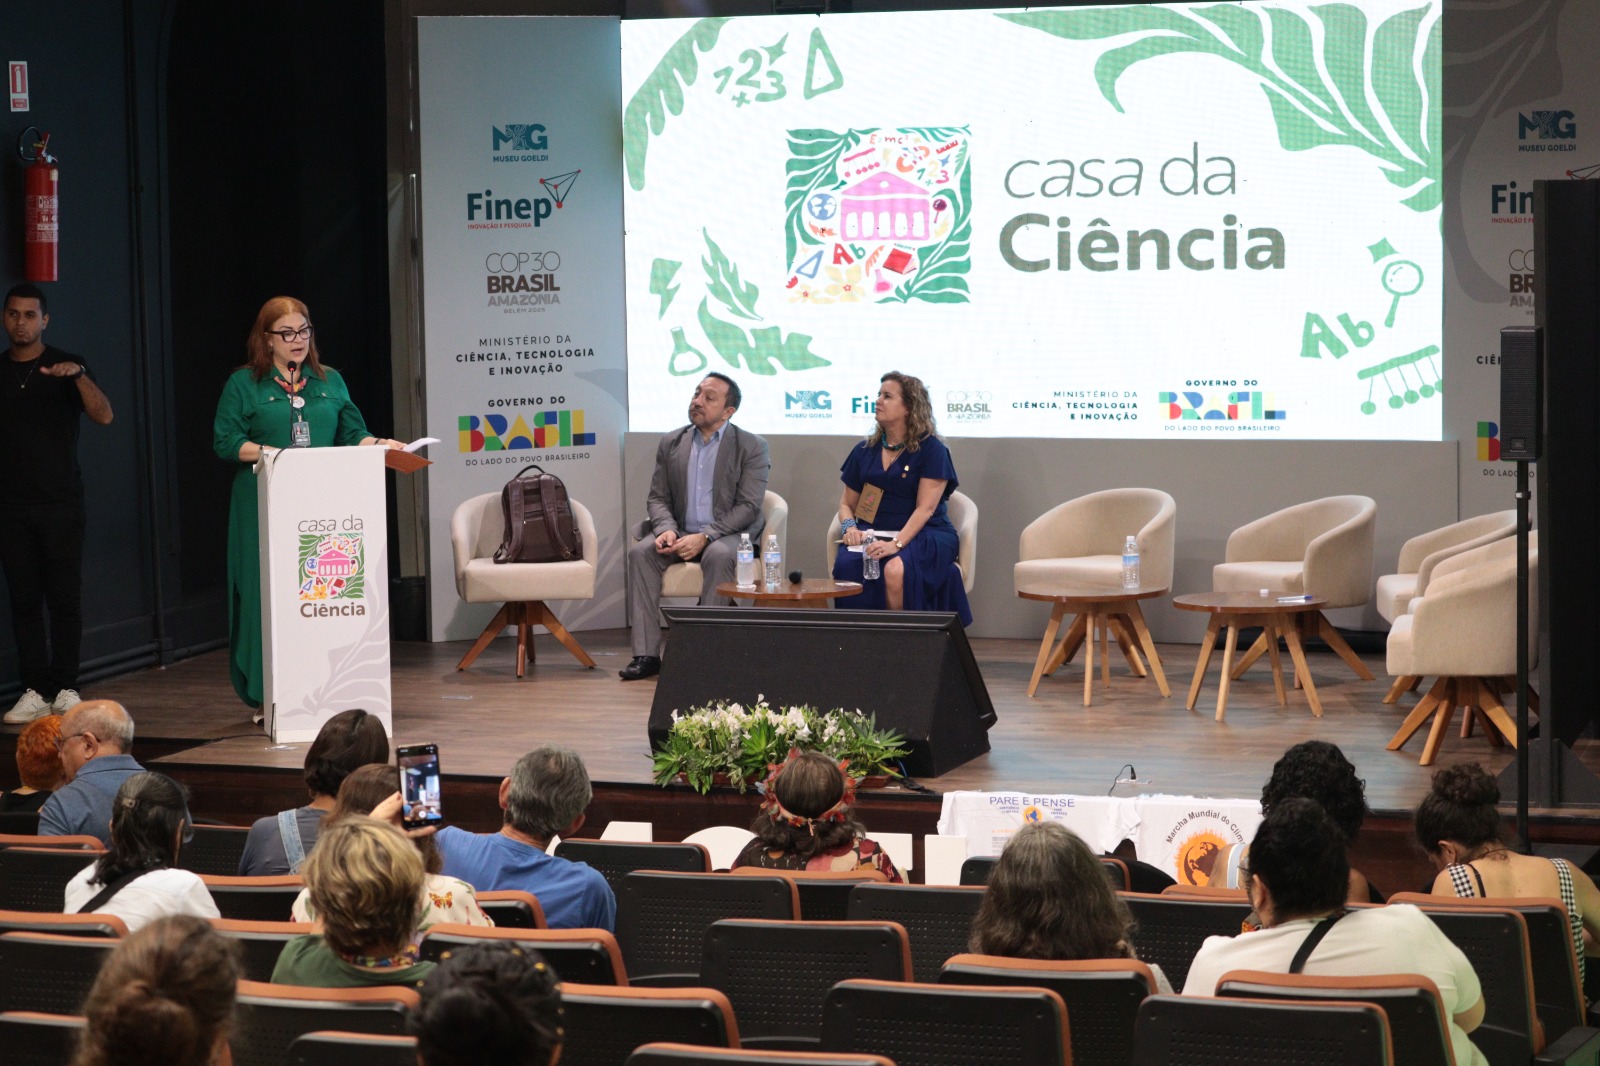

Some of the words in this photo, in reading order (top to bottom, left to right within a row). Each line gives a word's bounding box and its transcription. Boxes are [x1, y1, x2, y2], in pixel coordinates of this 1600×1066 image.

[1518, 144, 1545, 152] MUSEU
[1547, 144, 1577, 152] GOELDI
[492, 155, 520, 163] MUSEU
[521, 154, 549, 162] GOELDI
[1003, 157, 1144, 199] casa
[1159, 141, 1236, 197] da
[466, 189, 552, 227] Finep
[467, 222, 499, 230] INOVAÇÃO
[1491, 217, 1523, 225] INOVAÇÃO
[998, 212, 1286, 273] Ciência
[486, 273, 561, 294] BRASIL
[487, 293, 561, 307] AMAZÔNIA
[479, 334, 550, 347] MINISTÉRIO
[556, 334, 572, 344] DA
[455, 351, 511, 363] CIÊNCIA,
[516, 348, 595, 360] TECNOLOGIA
[488, 367, 495, 376] E
[500, 362, 563, 376] INOVAÇÃO
[1185, 379, 1237, 387] GOVERNO
[1053, 390, 1119, 398] MINISTÉRIO
[487, 397, 544, 408] GOVERNO
[550, 396, 566, 405] DO
[947, 402, 992, 413] BRASIL
[1012, 400, 1062, 410] CIÊNCIA,
[1081, 411, 1138, 421] INOVAÇÃO
[458, 409, 596, 453] BRASIL
[480, 457, 502, 465] LADO
[505, 456, 517, 464] DO
[519, 455, 542, 463] POVO
[545, 452, 590, 461] BRASILEIRO
[1483, 468, 1495, 477] DO
[297, 519, 337, 532] casa
[341, 513, 364, 531] da
[300, 601, 365, 618] Ciência
[989, 796, 1019, 806] PARE
[1022, 796, 1030, 806] E
[1033, 797, 1076, 808] PENSE
[1165, 817, 1188, 844] Marcha
[1187, 809, 1221, 821] Mundial
[1220, 815, 1230, 826] do
